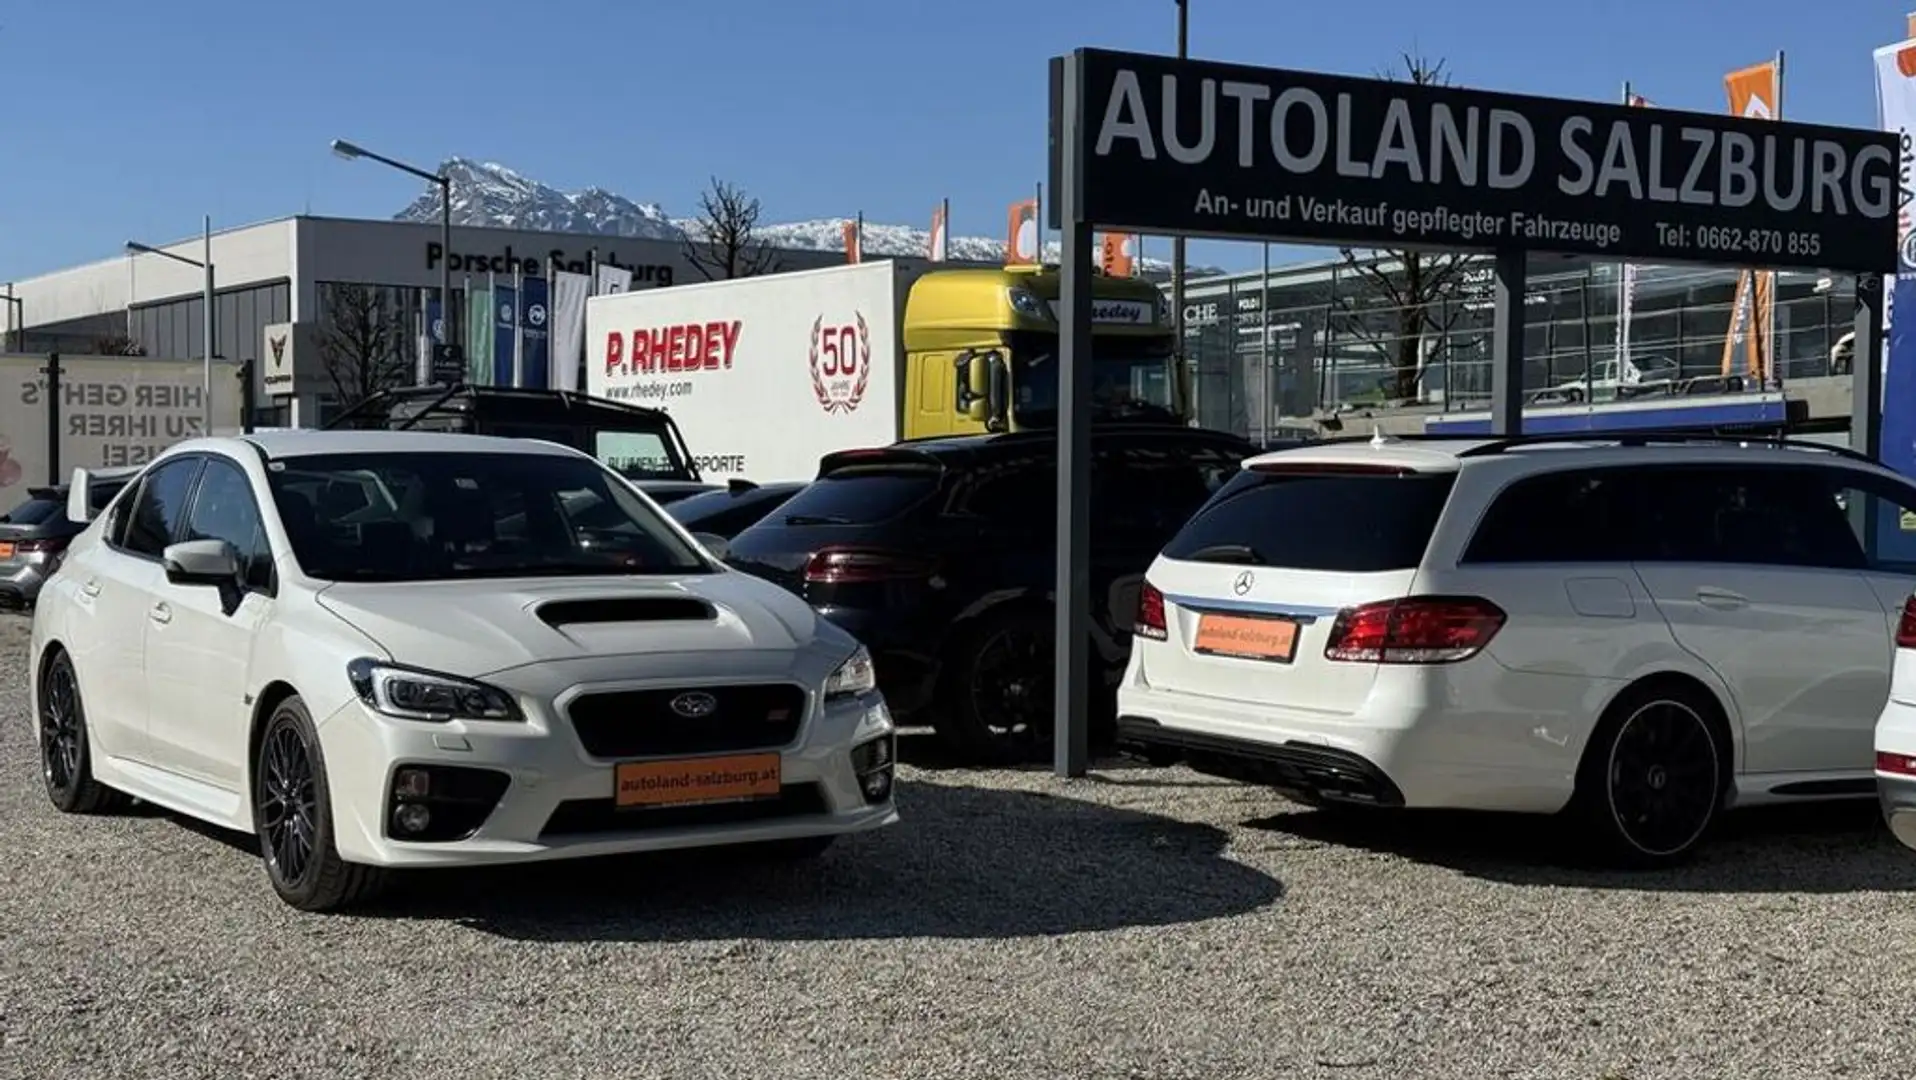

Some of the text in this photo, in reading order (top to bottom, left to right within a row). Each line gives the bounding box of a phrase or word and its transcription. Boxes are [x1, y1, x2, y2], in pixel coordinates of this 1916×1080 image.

[1095, 68, 1893, 219] AUTOLAND SALZBURG
[1194, 188, 1821, 256] An- und Verkauf gepflegter Fahrzeuge Tel: 0662-870 855
[426, 243, 540, 275] Porsche
[1183, 303, 1217, 321] CHE
[823, 326, 856, 376] 50
[606, 381, 692, 401] www.rhedey.com
[621, 767, 777, 792] autoland-salzburg.at
